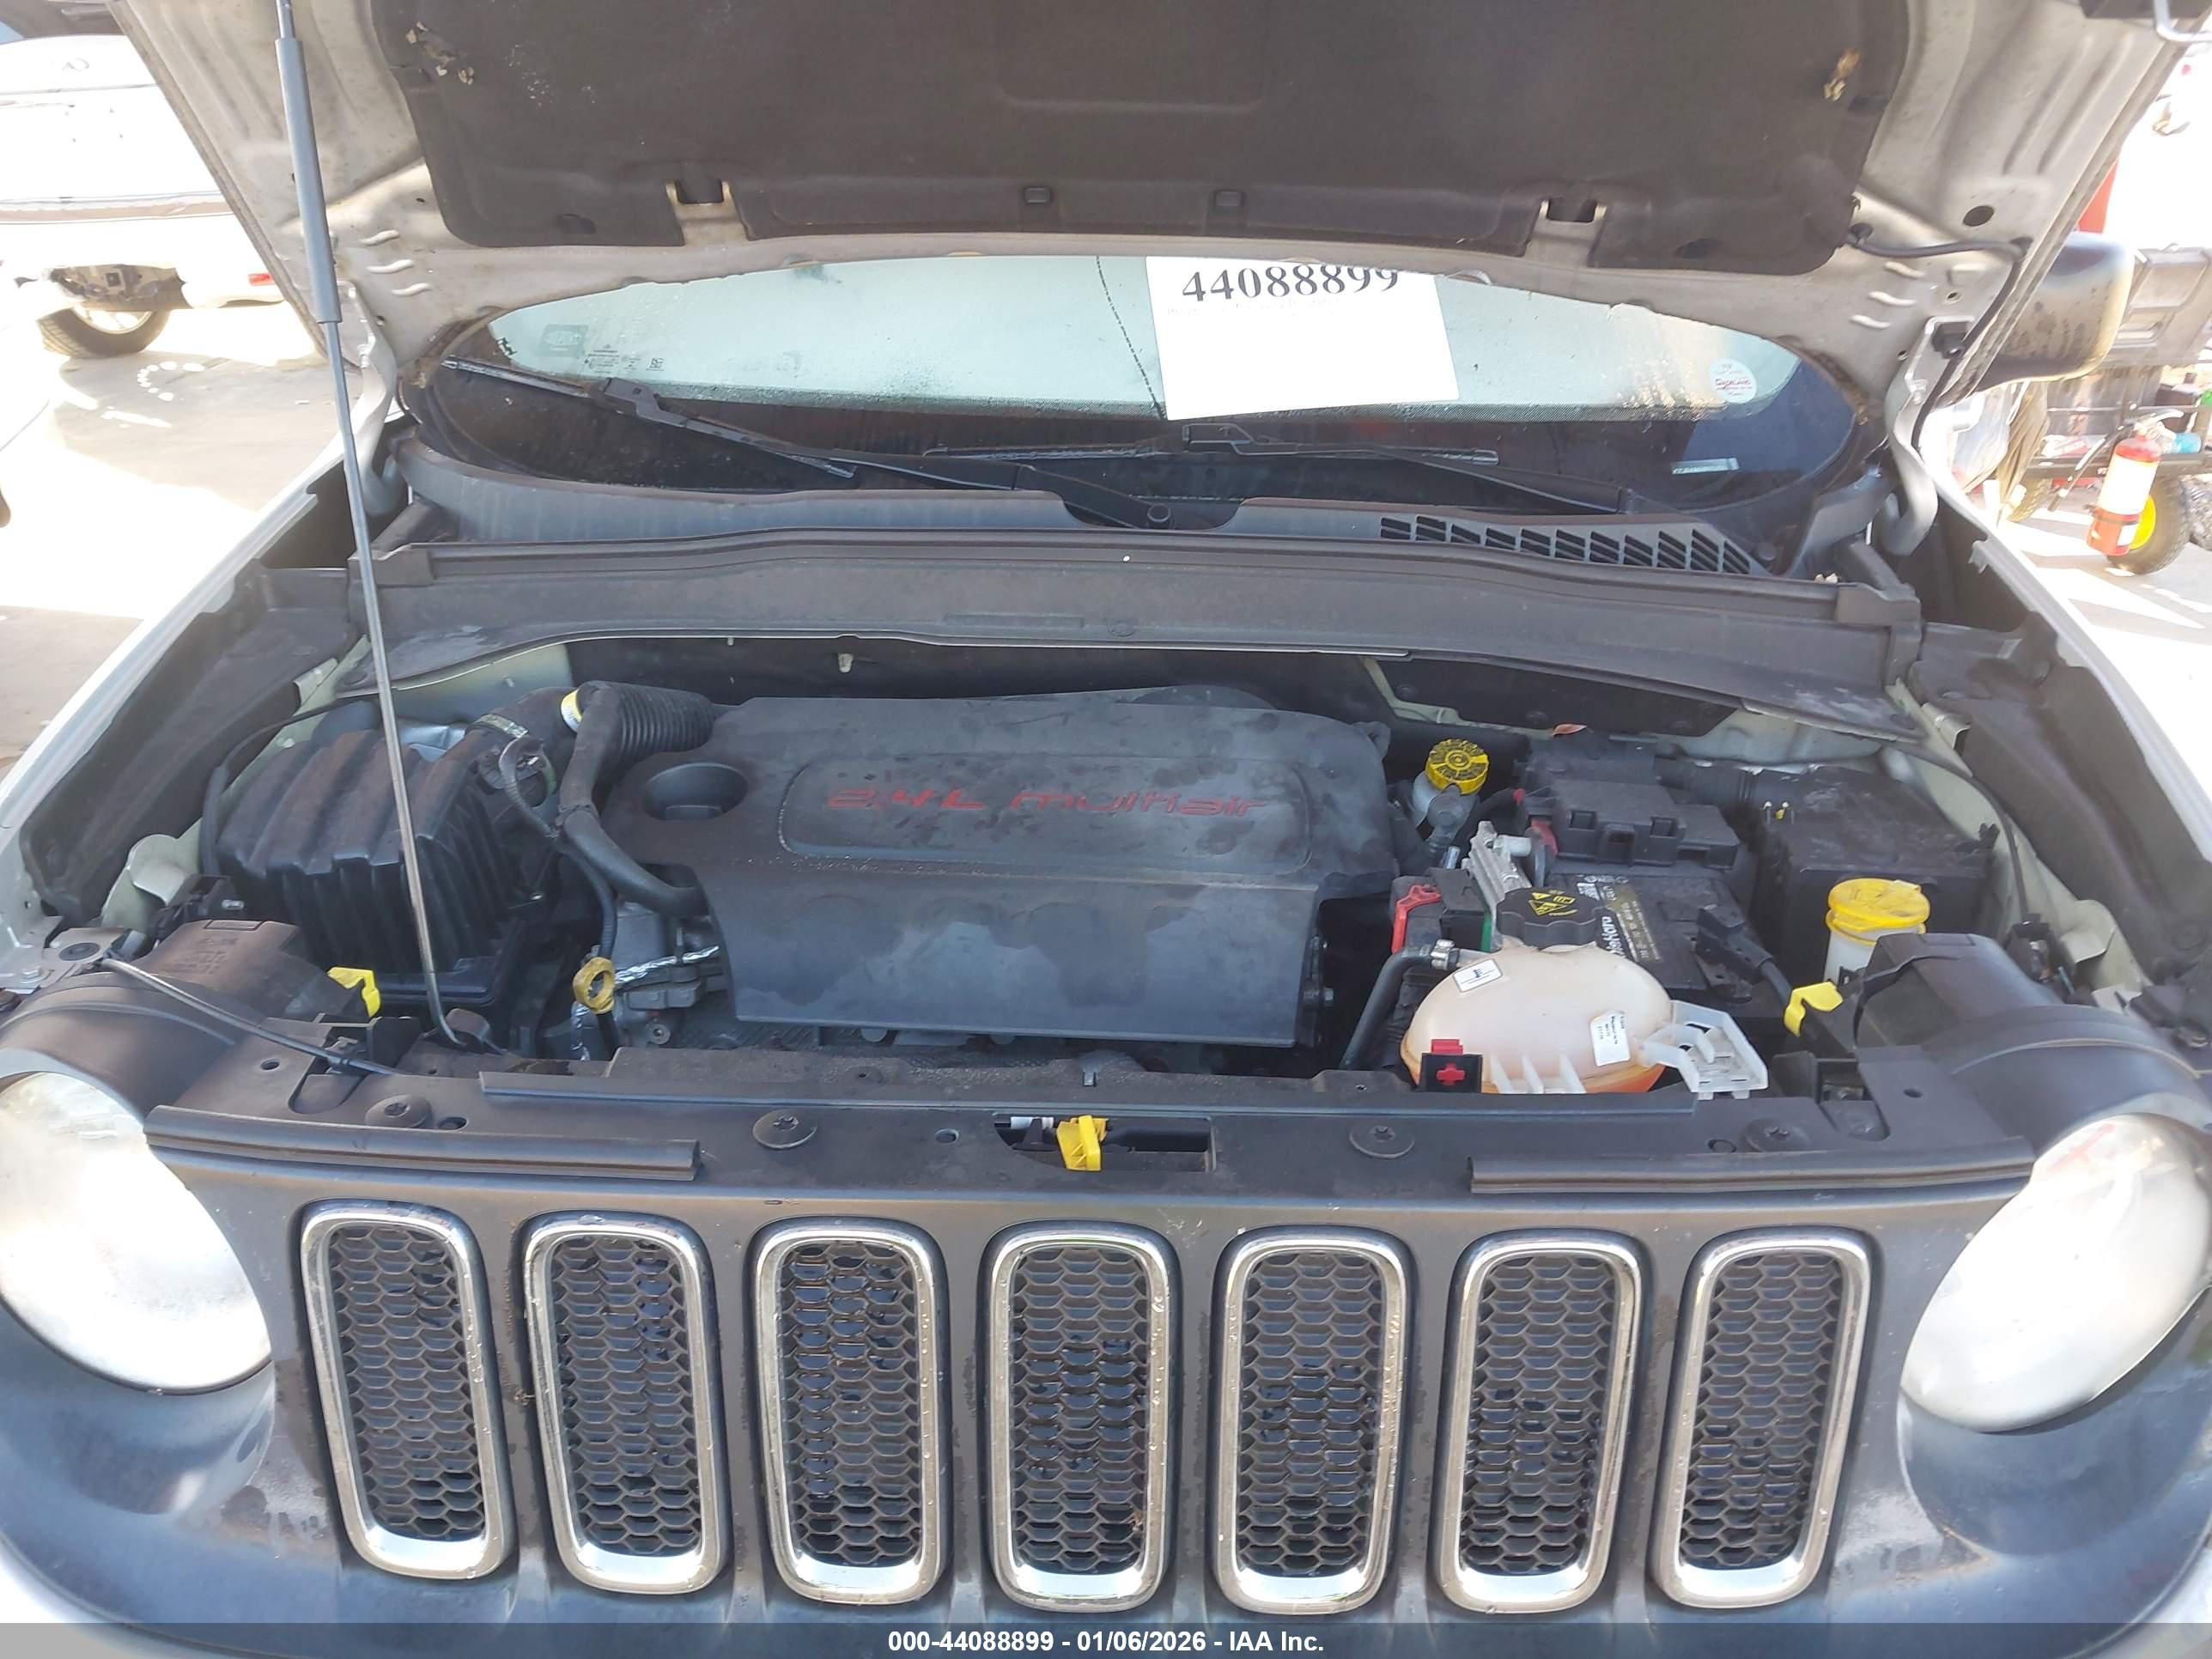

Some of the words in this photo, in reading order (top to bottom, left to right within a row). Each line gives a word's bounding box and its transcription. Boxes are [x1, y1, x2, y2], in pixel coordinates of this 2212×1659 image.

[1182, 264, 1398, 301] 44088899
[827, 788, 986, 811] 2.4L
[1010, 790, 1267, 819] multiair
